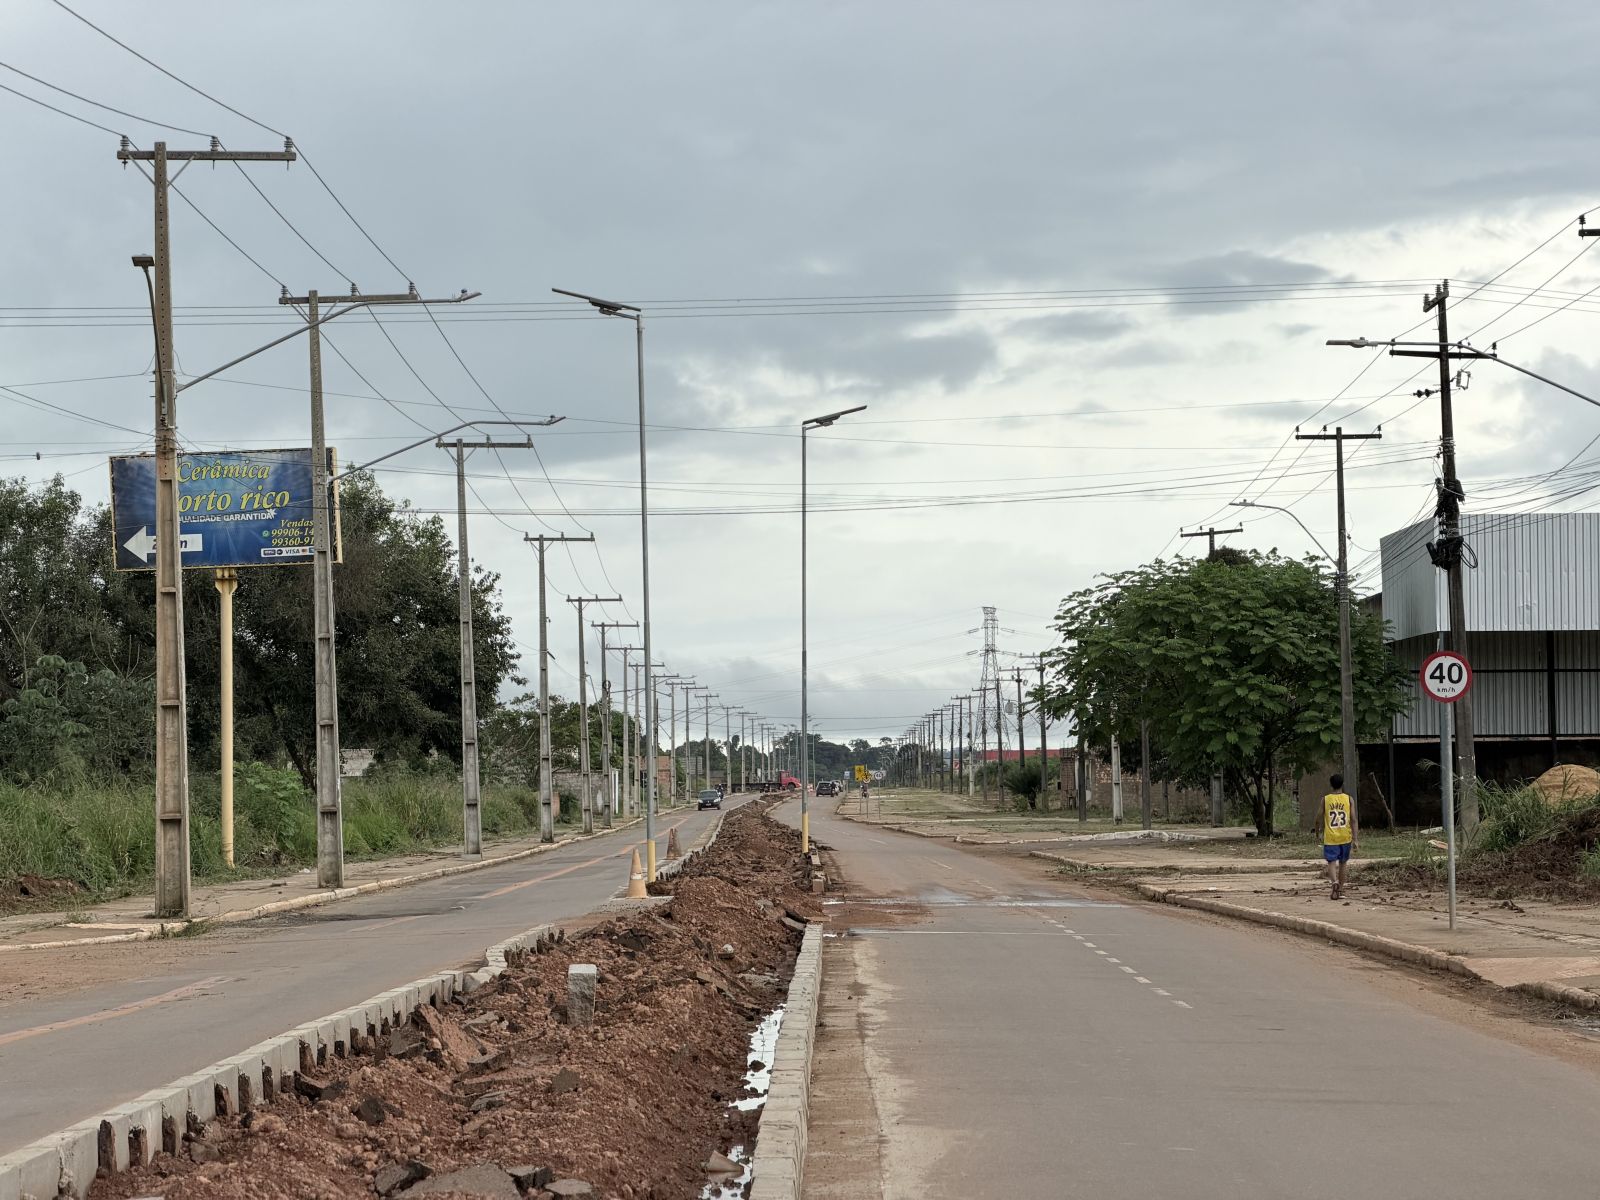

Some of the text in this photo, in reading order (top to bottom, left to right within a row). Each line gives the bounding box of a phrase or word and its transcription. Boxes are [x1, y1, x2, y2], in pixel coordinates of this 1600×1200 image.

[177, 459, 271, 483] Cerâmica
[178, 484, 291, 513] orto rico
[179, 511, 273, 524] UALIDADE GARANTIDA
[281, 518, 314, 528] Vendas
[271, 527, 315, 538] 99906-14
[271, 536, 315, 547] 99360-91
[1429, 662, 1463, 685] 40
[1329, 810, 1347, 828] 23
